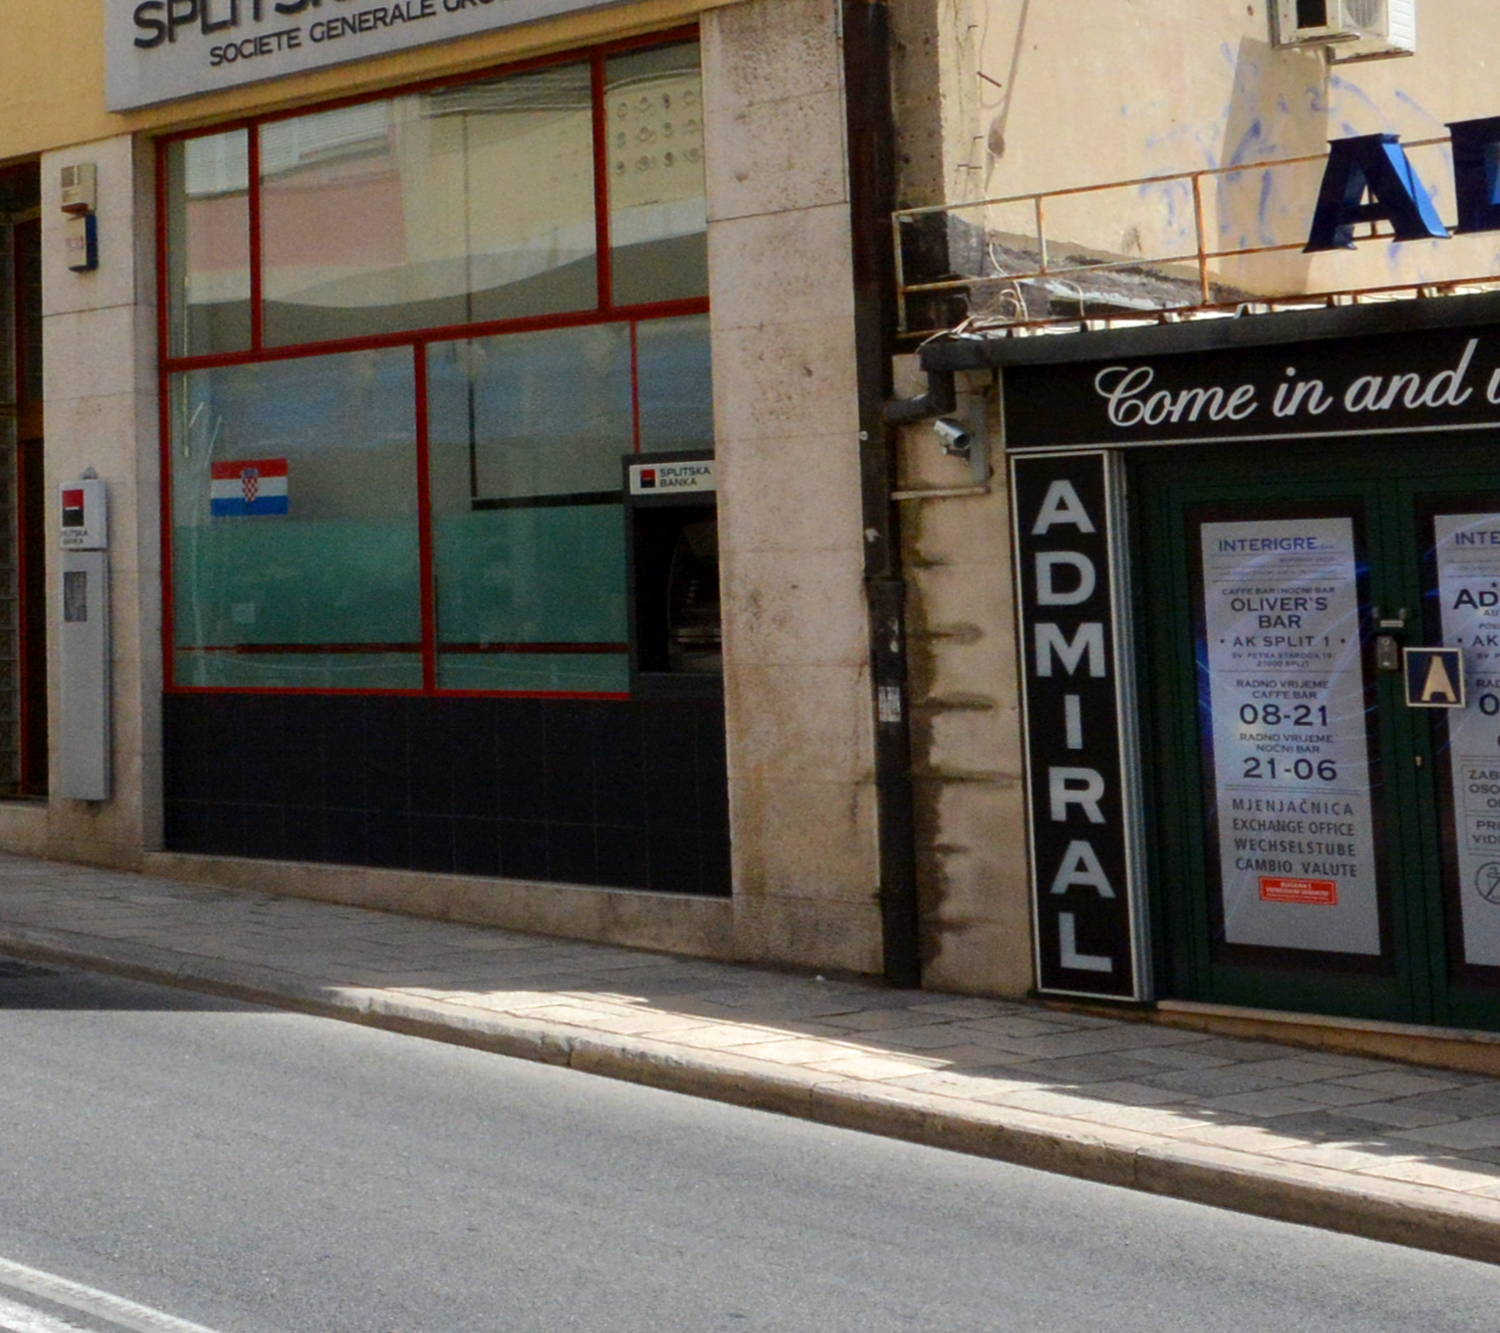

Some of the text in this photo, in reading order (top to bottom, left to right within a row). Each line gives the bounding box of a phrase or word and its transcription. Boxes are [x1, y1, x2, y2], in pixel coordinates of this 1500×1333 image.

[210, 27, 302, 67] SOCIETE
[1095, 366, 1259, 427] Come
[1273, 367, 1333, 418] in
[1343, 338, 1478, 412] and
[660, 467, 711, 477] SPLITSKA
[660, 478, 698, 487] BANKA
[1219, 537, 1317, 552] INTERIGRE
[1231, 597, 1328, 612] OLIVER'S
[1258, 615, 1301, 629] BAR
[1233, 636, 1330, 647] AK SPLIT 1
[1472, 635, 1498, 647] AK
[1236, 679, 1330, 689] RADNO VRIJEME
[1252, 691, 1317, 699] CAFFE BAR
[1239, 703, 1328, 727] 08-21
[1031, 479, 1117, 973] ADMIRAL
[1239, 733, 1333, 744] RADNO VRIJEME
[1296, 745, 1320, 754] BAR
[1243, 757, 1338, 781] 21-06
[1232, 797, 1354, 816] MJENJAČNICA
[1233, 819, 1355, 837] EXCHANGE OFFICE
[1234, 838, 1356, 857] WECHSELSTUBE
[1236, 858, 1357, 877] CAMBIO VALUTE
